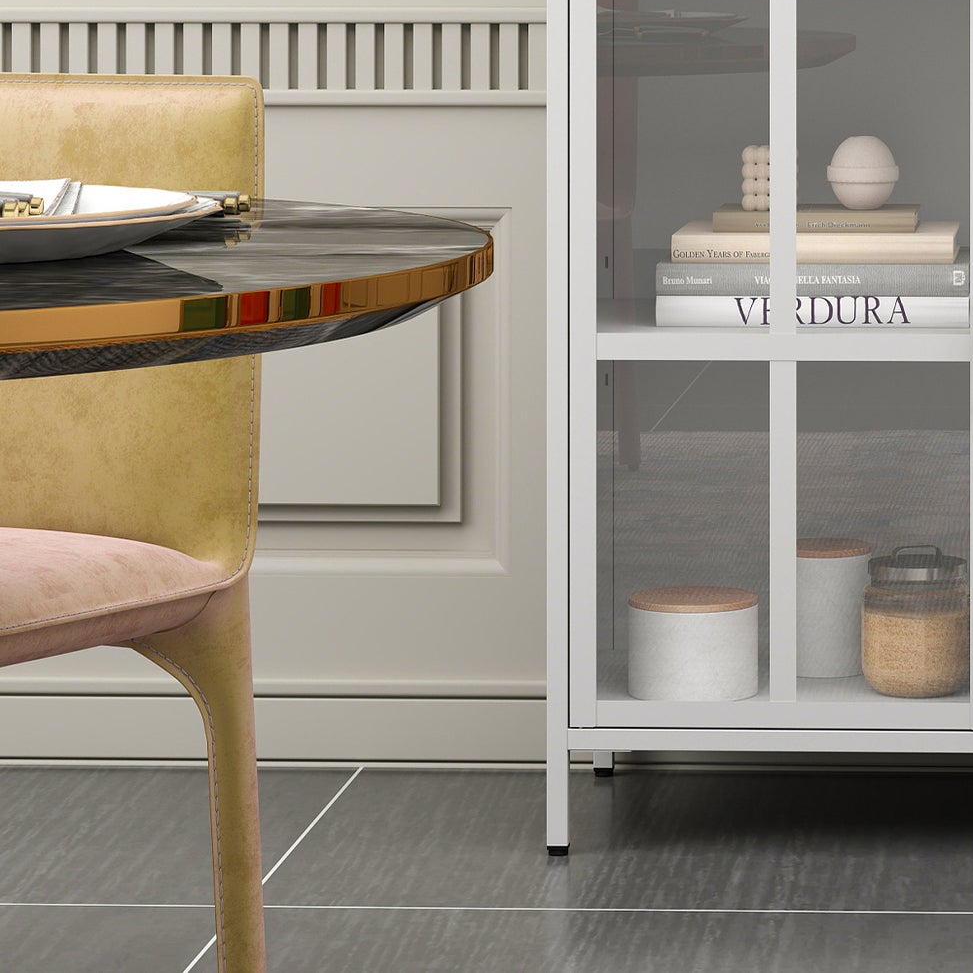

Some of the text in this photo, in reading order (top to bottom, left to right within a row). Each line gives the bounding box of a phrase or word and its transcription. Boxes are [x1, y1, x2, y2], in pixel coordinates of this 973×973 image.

[662, 276, 713, 285] Bruno Munari
[796, 276, 820, 285] ELLA
[821, 275, 862, 285] FANTASIA
